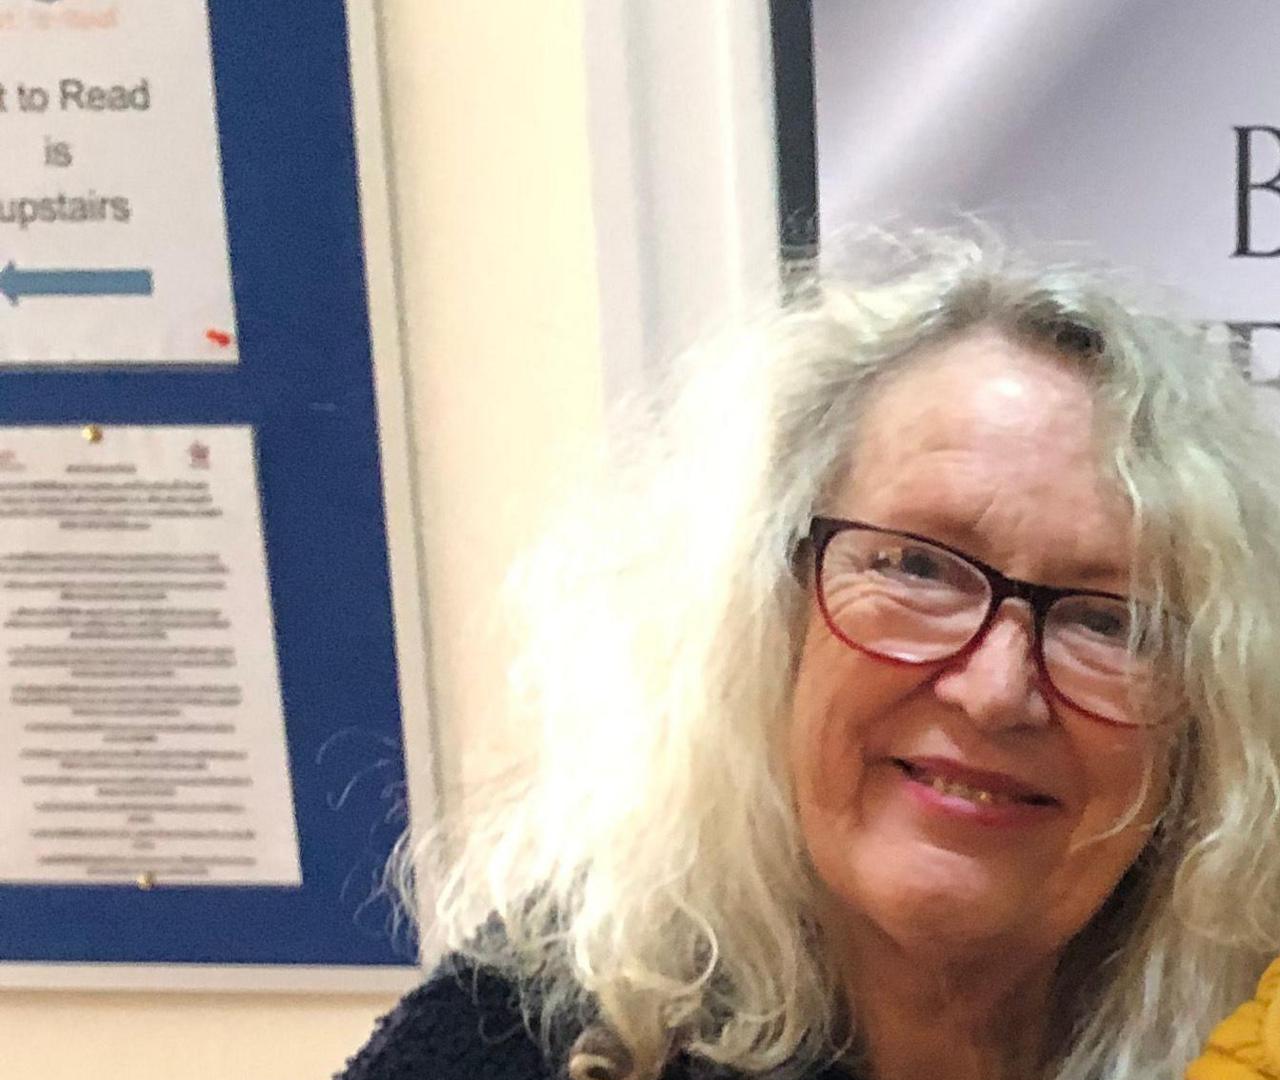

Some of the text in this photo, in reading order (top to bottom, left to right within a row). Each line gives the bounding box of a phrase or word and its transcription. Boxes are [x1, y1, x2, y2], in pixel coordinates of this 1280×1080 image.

[18, 84, 49, 113] to
[60, 79, 150, 112] Read
[45, 135, 73, 167] is
[0, 190, 132, 230] upstairs
